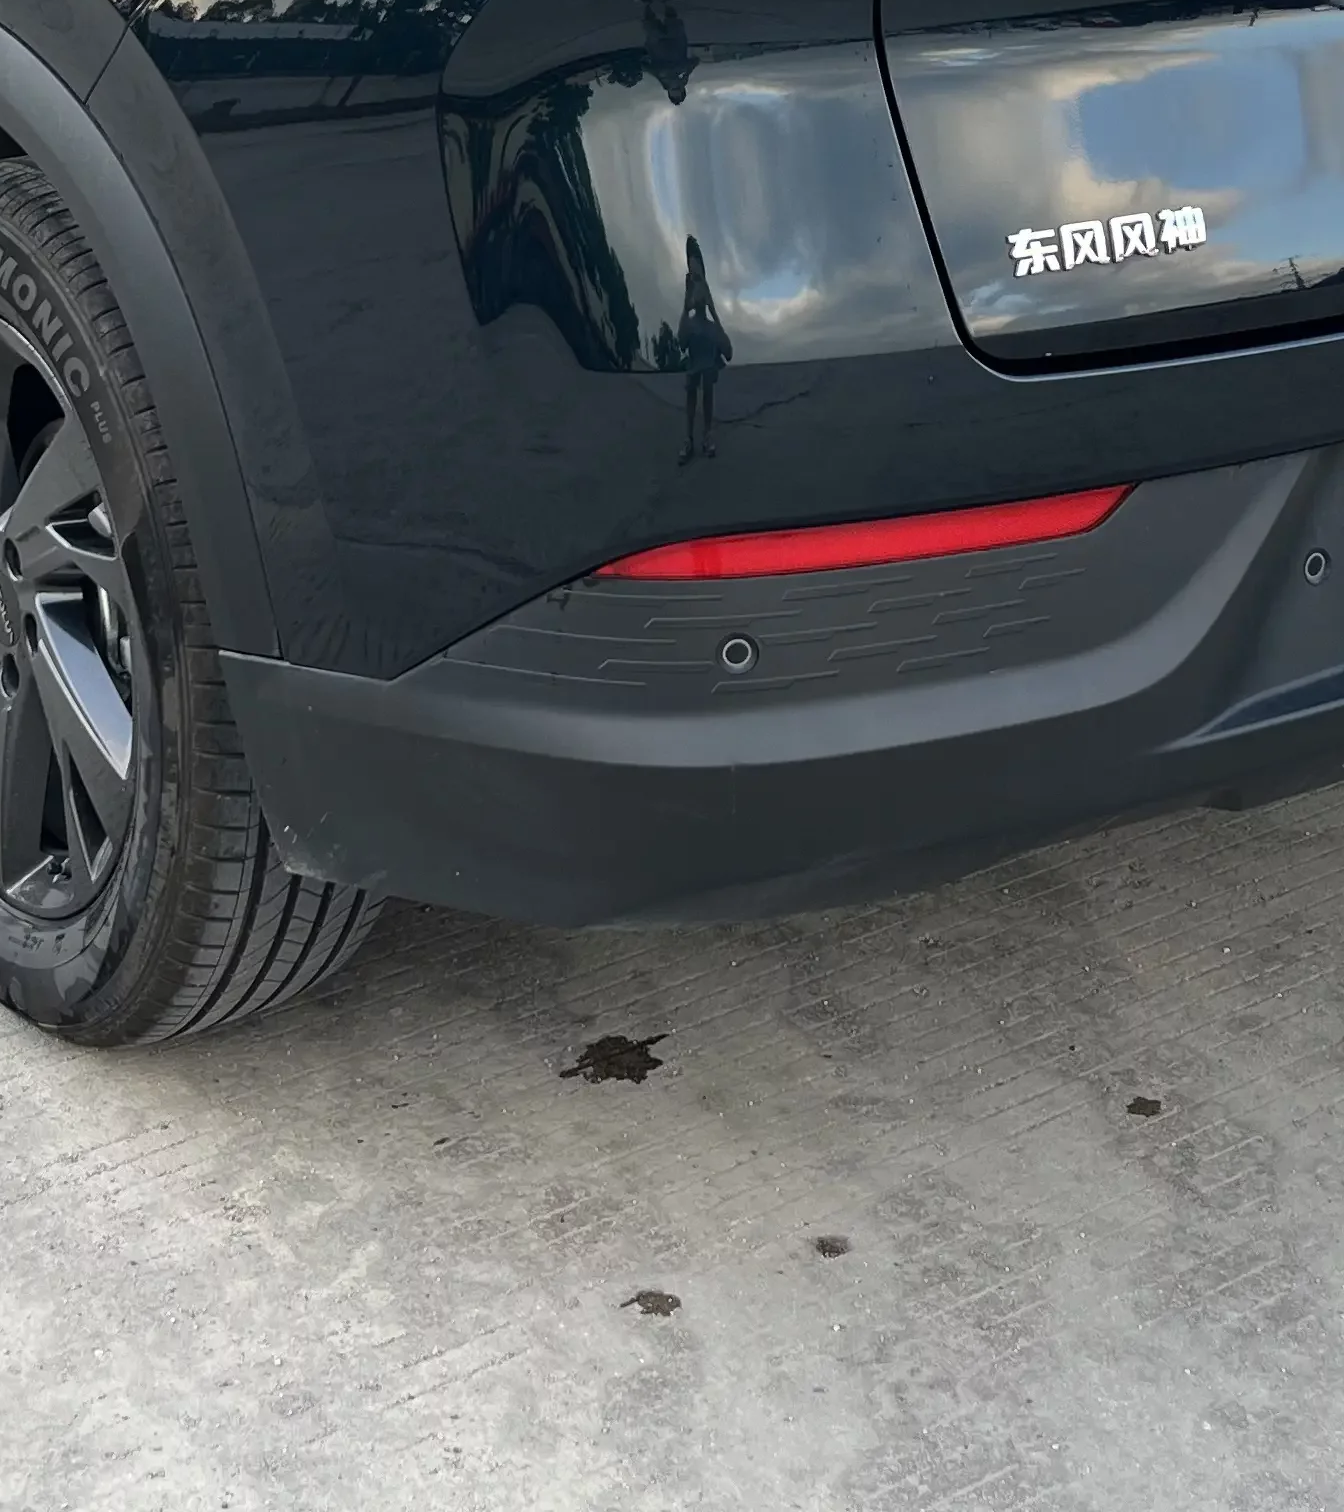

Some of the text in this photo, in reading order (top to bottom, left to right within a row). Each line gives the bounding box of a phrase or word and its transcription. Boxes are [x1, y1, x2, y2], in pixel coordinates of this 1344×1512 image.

[1007, 206, 1207, 278] 东风风神
[90, 401, 112, 444] PLUS
